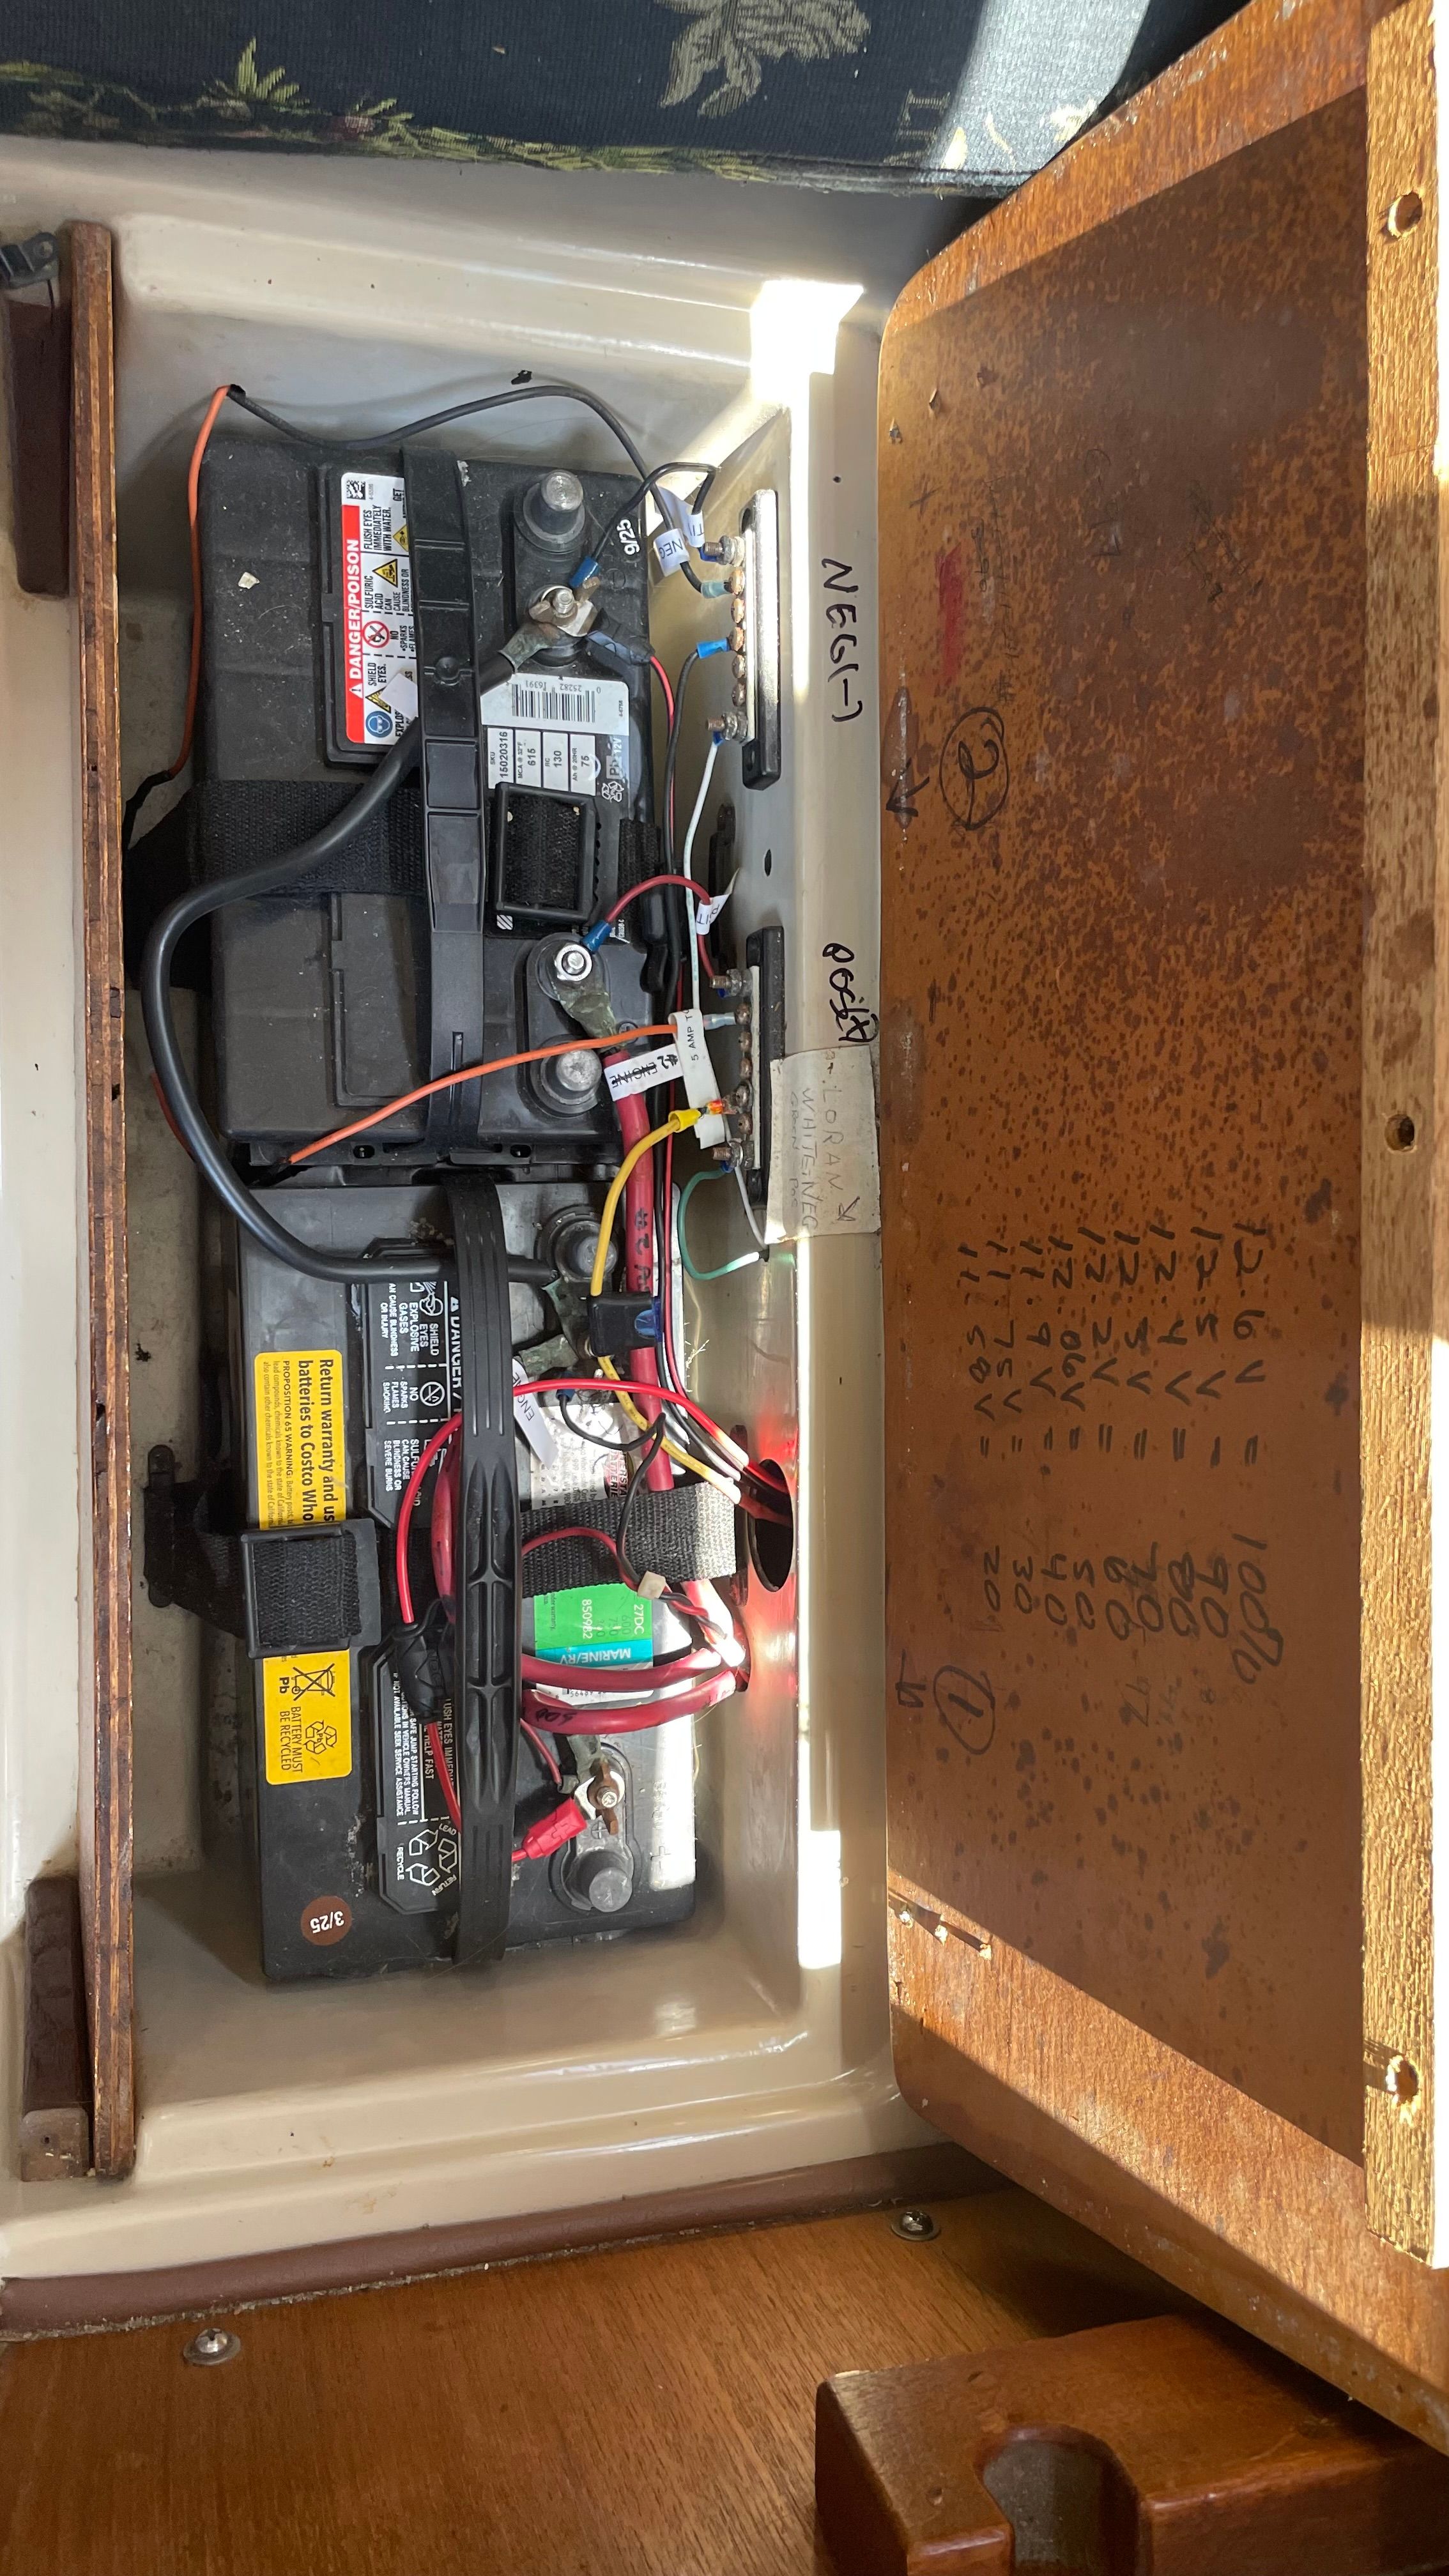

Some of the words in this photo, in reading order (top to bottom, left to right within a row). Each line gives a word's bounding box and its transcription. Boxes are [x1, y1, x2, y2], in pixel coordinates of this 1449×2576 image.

[393, 488, 402, 502] GET
[364, 509, 372, 528] EYES
[372, 505, 382, 551] IMMEDIATELY
[383, 507, 392, 532] WATER.
[364, 529, 372, 549] FLUSH
[383, 534, 392, 551] WITH
[617, 519, 640, 555] 9/25
[401, 569, 409, 577] OR
[364, 576, 373, 608] SULFURIC
[374, 593, 383, 610] ACID
[393, 592, 401, 611] CAUSE
[347, 539, 362, 679] DANGER/POISON
[390, 631, 399, 640] NO
[368, 663, 377, 686] SHIELD
[499, 732, 509, 778] 15020316
[527, 748, 536, 766] 615
[613, 737, 622, 754] 12V
[553, 750, 562, 768] 130
[581, 755, 590, 767] 75
[687, 1026, 696, 1048] AMP
[823, 1087, 844, 1190] LORAN
[1233, 1222, 1266, 1341] 12.6
[381, 1302, 388, 1312] OR
[399, 1303, 408, 1333] GASES
[390, 1319, 398, 1356] BLINDNESS
[409, 1302, 419, 1352] EXPLOSIVE
[420, 1324, 428, 1347] EYES
[430, 1323, 439, 1356] SHIELD
[319, 1359, 334, 1406] Return
[1029, 1367, 1055, 1397] V
[1126, 1370, 1151, 1395] V
[1234, 1359, 1266, 1384] V
[263, 1374, 272, 1395] contain
[272, 1374, 281, 1409] compounds,
[298, 1360, 314, 1421] batteries
[391, 1381, 399, 1408] FLAMES
[400, 1381, 408, 1408] SPARKS
[409, 1387, 418, 1401] NO
[1165, 1370, 1192, 1406] V
[1195, 1370, 1227, 1400] V
[383, 1382, 391, 1413] SMOKING
[285, 1421, 292, 1432] 65
[300, 1424, 312, 1438] to
[318, 1410, 335, 1472] warranty
[302, 1442, 316, 1486] Costco
[284, 1480, 293, 1500] Battery
[323, 1476, 338, 1501] and
[394, 1480, 402, 1491] OR
[302, 1490, 318, 1524] Who
[984, 1545, 1002, 1612] 20
[1013, 1558, 1034, 1614] 30
[1041, 1554, 1067, 1626] 40
[1074, 1560, 1096, 1630] 50
[1103, 1556, 1130, 1640] 60
[1195, 1555, 1229, 1639] 90
[582, 1599, 592, 1639] 850982
[633, 1604, 644, 1635] 27DC
[1231, 1533, 1284, 1685] 100%
[621, 1615, 631, 1634] 600
[560, 1648, 631, 1664] MARINE/RV
[279, 1677, 289, 1694] Pb
[280, 1712, 289, 1722] BE
[291, 1706, 302, 1745] BATTERY
[317, 1733, 323, 1742] Pb
[443, 1723, 453, 1744] EYES
[280, 1725, 291, 1770] RECYCLED
[292, 1747, 302, 1772] MUST
[425, 1759, 434, 1779] FAST
[310, 1911, 345, 1935] 3/25
